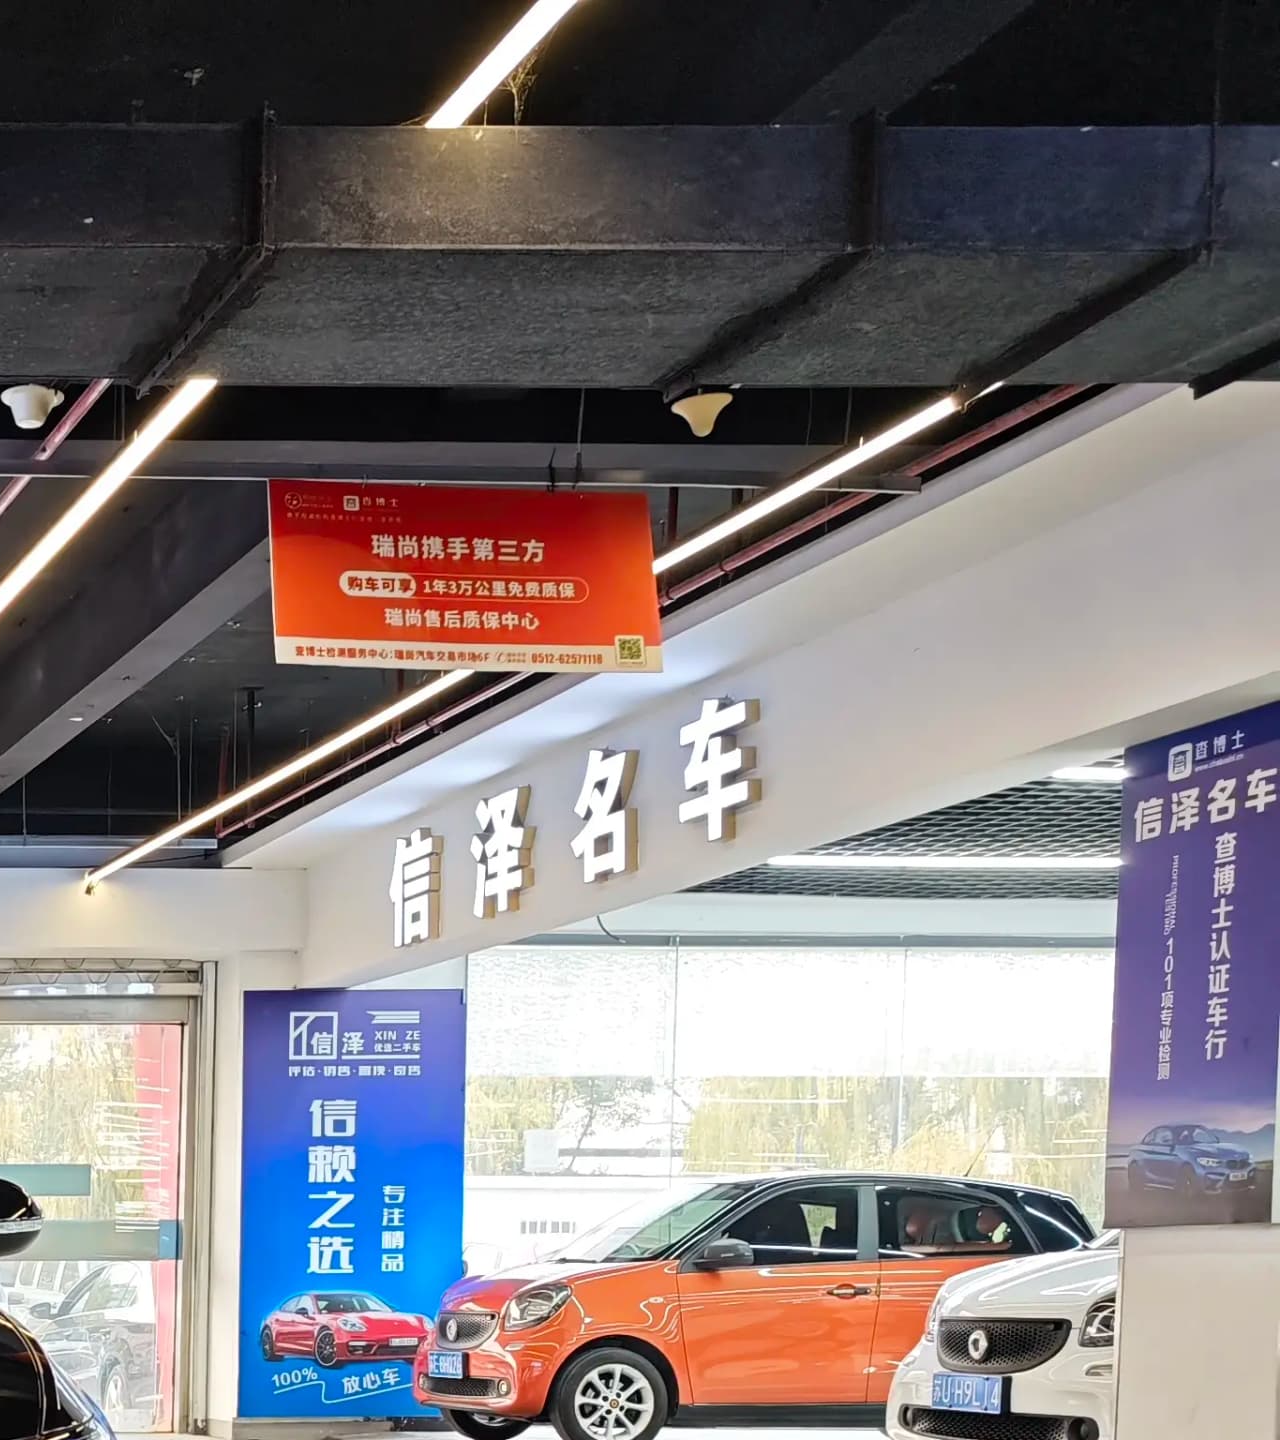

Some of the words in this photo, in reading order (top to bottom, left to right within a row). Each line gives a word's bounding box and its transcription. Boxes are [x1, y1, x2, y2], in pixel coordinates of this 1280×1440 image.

[371, 533, 545, 563] 瑞尚携手第三方
[347, 575, 414, 593] 购车可享
[422, 579, 576, 600] 1年3万公里免费质保
[384, 607, 540, 631] 瑞尚售后质保中心
[390, 697, 762, 948] 信泽名车
[1134, 768, 1278, 843] 信泽名车
[1205, 832, 1238, 1061] 查博士认证车行
[374, 1030, 397, 1041] XIN
[405, 1030, 421, 1041] ZE
[306, 1099, 358, 1275] 信赖之选
[381, 1184, 406, 1272] 专注精品
[271, 1366, 318, 1387] 100%
[342, 1367, 401, 1395] 放心车
